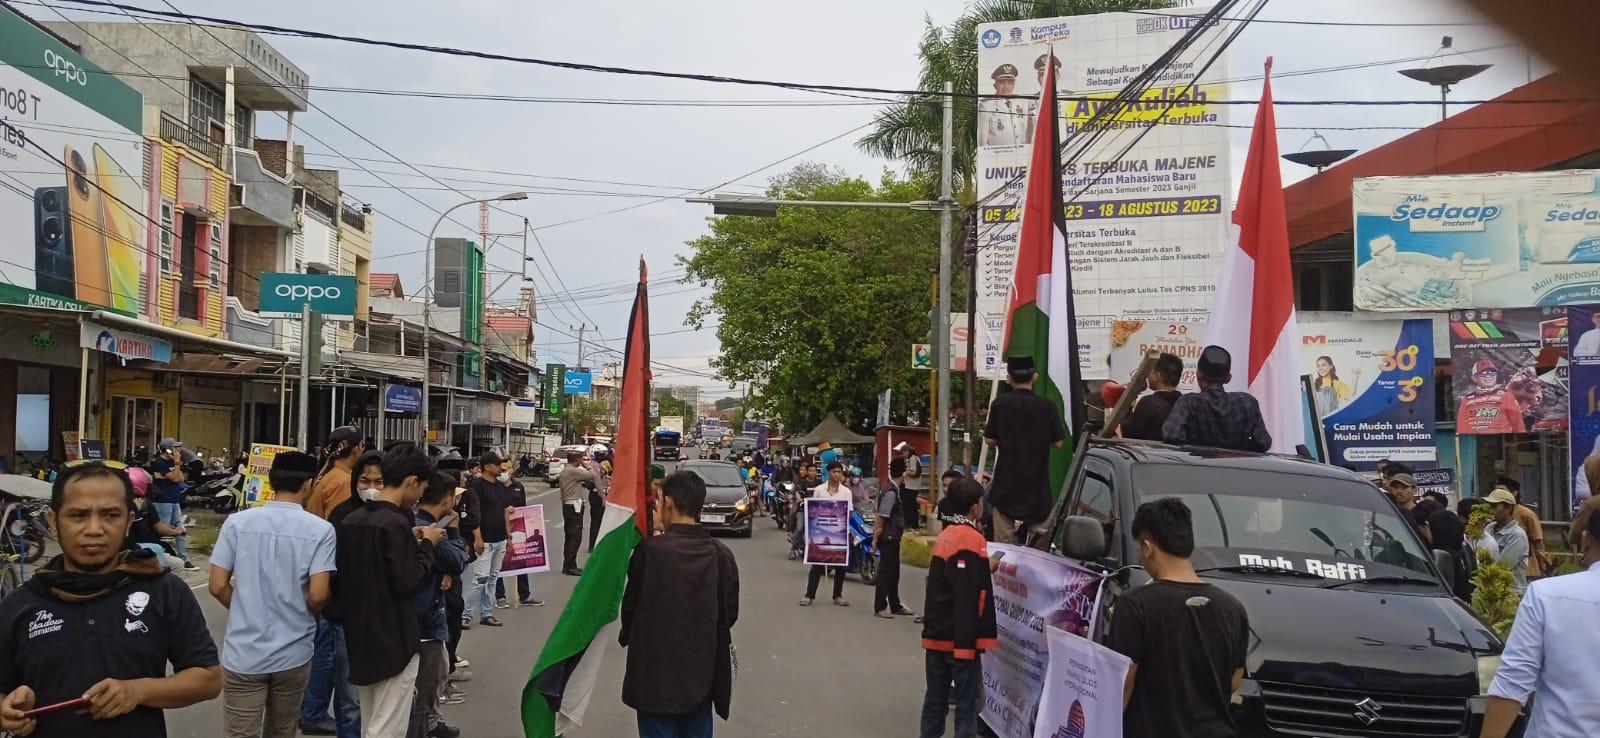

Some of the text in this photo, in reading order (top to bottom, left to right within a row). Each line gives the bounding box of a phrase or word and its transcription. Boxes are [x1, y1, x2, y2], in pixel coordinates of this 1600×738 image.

[1031, 22, 1067, 34] Kampus
[1031, 29, 1071, 41] Merdeka
[44, 49, 87, 86] oppo
[1086, 65, 1140, 76] Mewujudkan
[1086, 77, 1121, 87] Sebagai
[0, 87, 41, 120] no8 T
[1127, 84, 1207, 113] Kuliah
[1163, 112, 1217, 126] Terbuka
[1082, 159, 1149, 175] TERBUKA
[1154, 155, 1216, 172] MAJENE
[1061, 172, 1196, 187] endaftaran Mahasiswa Baru
[1086, 188, 1114, 197] Sarjana
[1116, 185, 1150, 193] Semester
[1153, 184, 1172, 192] 2023
[1174, 183, 1196, 192] Ganjil
[1405, 194, 1429, 203] Mie
[985, 208, 1003, 222] 05
[1098, 203, 1114, 217] 18
[1118, 201, 1179, 216] AGUSTUS
[1183, 198, 1218, 213] 2023
[1391, 202, 1499, 222] Sedaap
[1543, 207, 1600, 222] Seda
[1099, 227, 1136, 238] Terbuka
[1079, 240, 1125, 248] Terakreditasi
[1086, 249, 1112, 257] dengan
[1114, 247, 1150, 255] Akreditasi
[1176, 252, 1210, 261] Fleksibel
[1098, 287, 1136, 296] Terbanyak
[1532, 277, 1553, 293] Mau
[275, 284, 341, 301] oppo
[115, 337, 153, 359] KARTIKA
[1378, 349, 1417, 372] 30
[1397, 379, 1416, 402] 3
[1333, 421, 1425, 431] Cara Mudah untuk
[1334, 431, 1432, 442] Mulai Usaha Impian
[1239, 554, 1366, 581] Muh Raffi
[35, 610, 54, 624] The
[29, 618, 65, 632] Shadow
